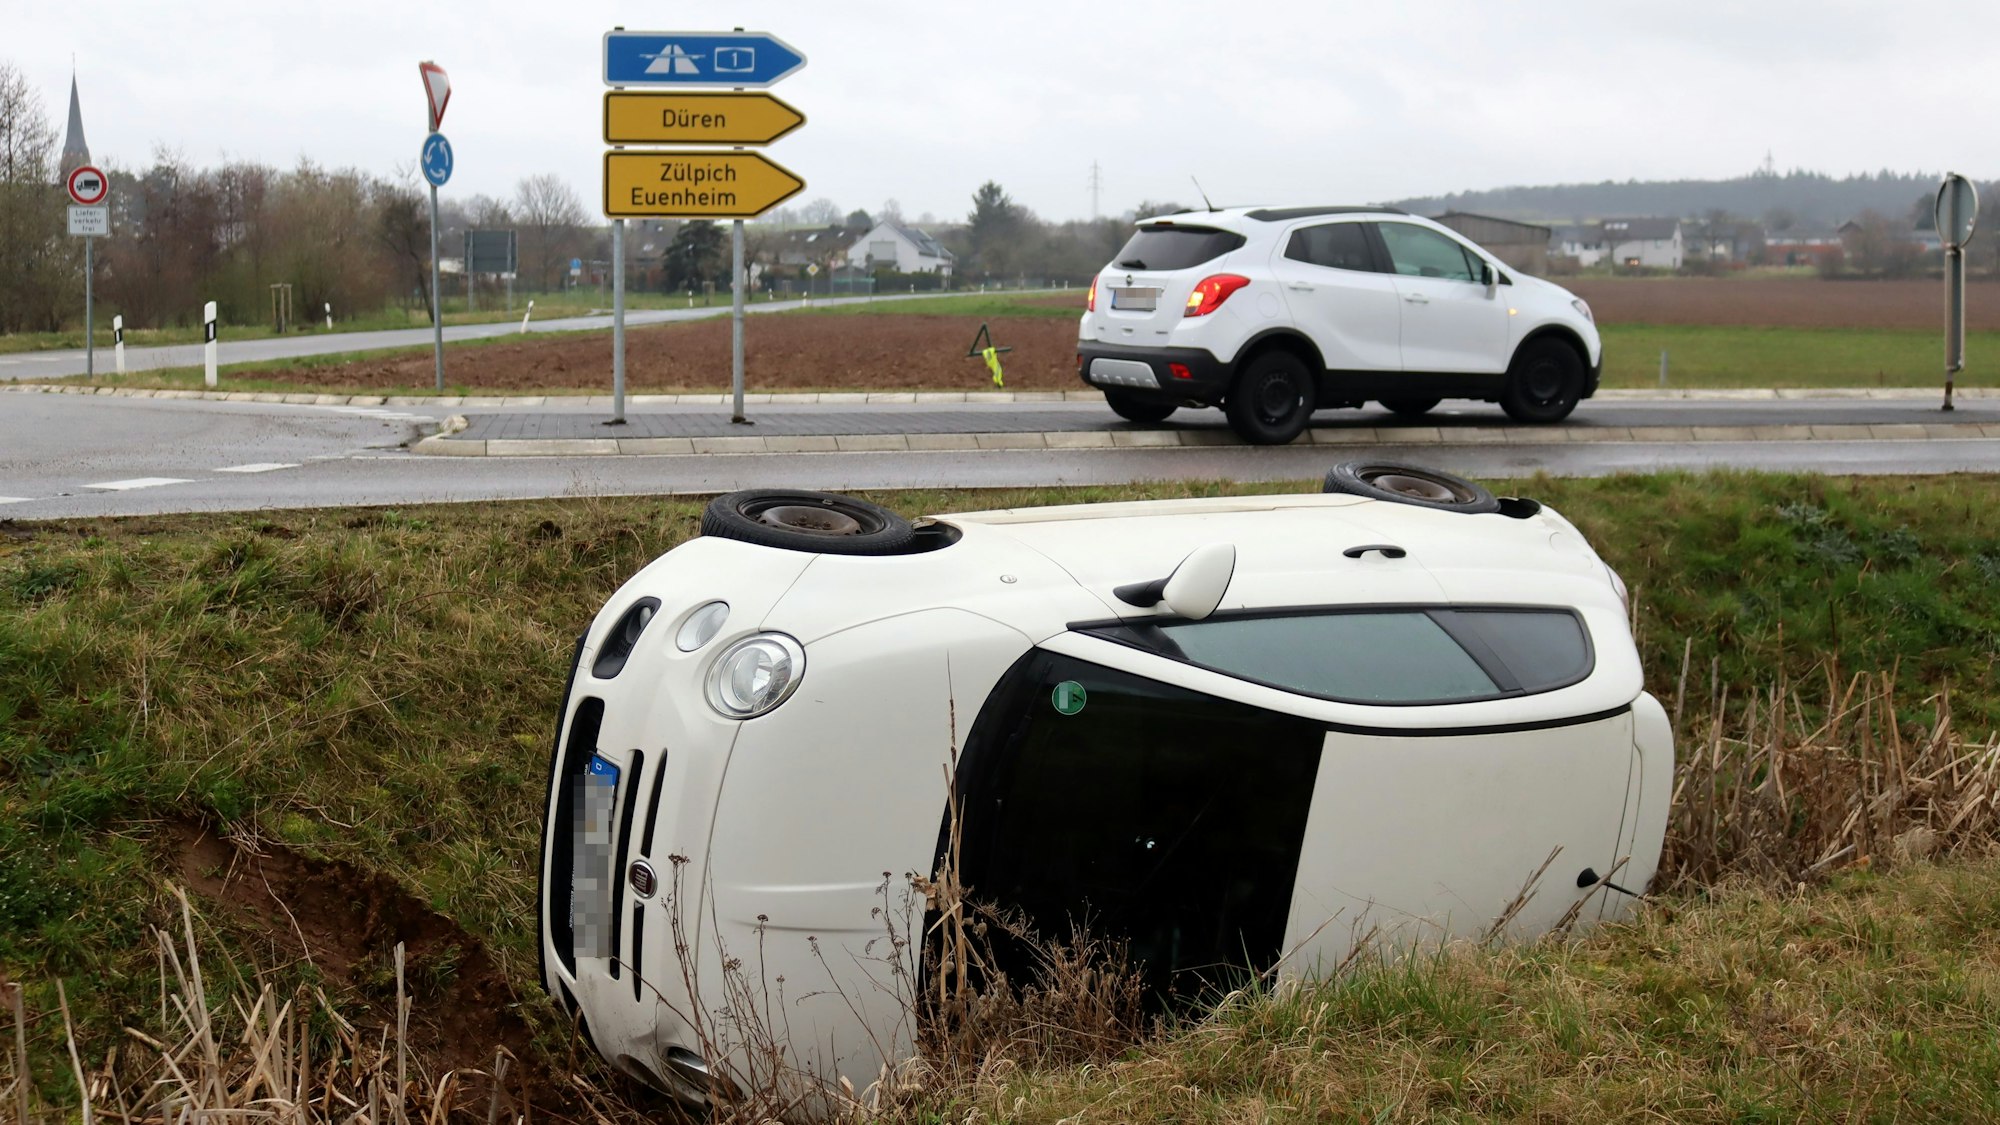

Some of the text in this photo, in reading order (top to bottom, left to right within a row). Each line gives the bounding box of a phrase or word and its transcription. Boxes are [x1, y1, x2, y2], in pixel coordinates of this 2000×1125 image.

[731, 52, 738, 67] 1
[662, 109, 726, 128] Düren
[660, 163, 736, 186] Zülpich
[631, 187, 736, 206] Euenheim
[634, 868, 648, 892] FIAT
